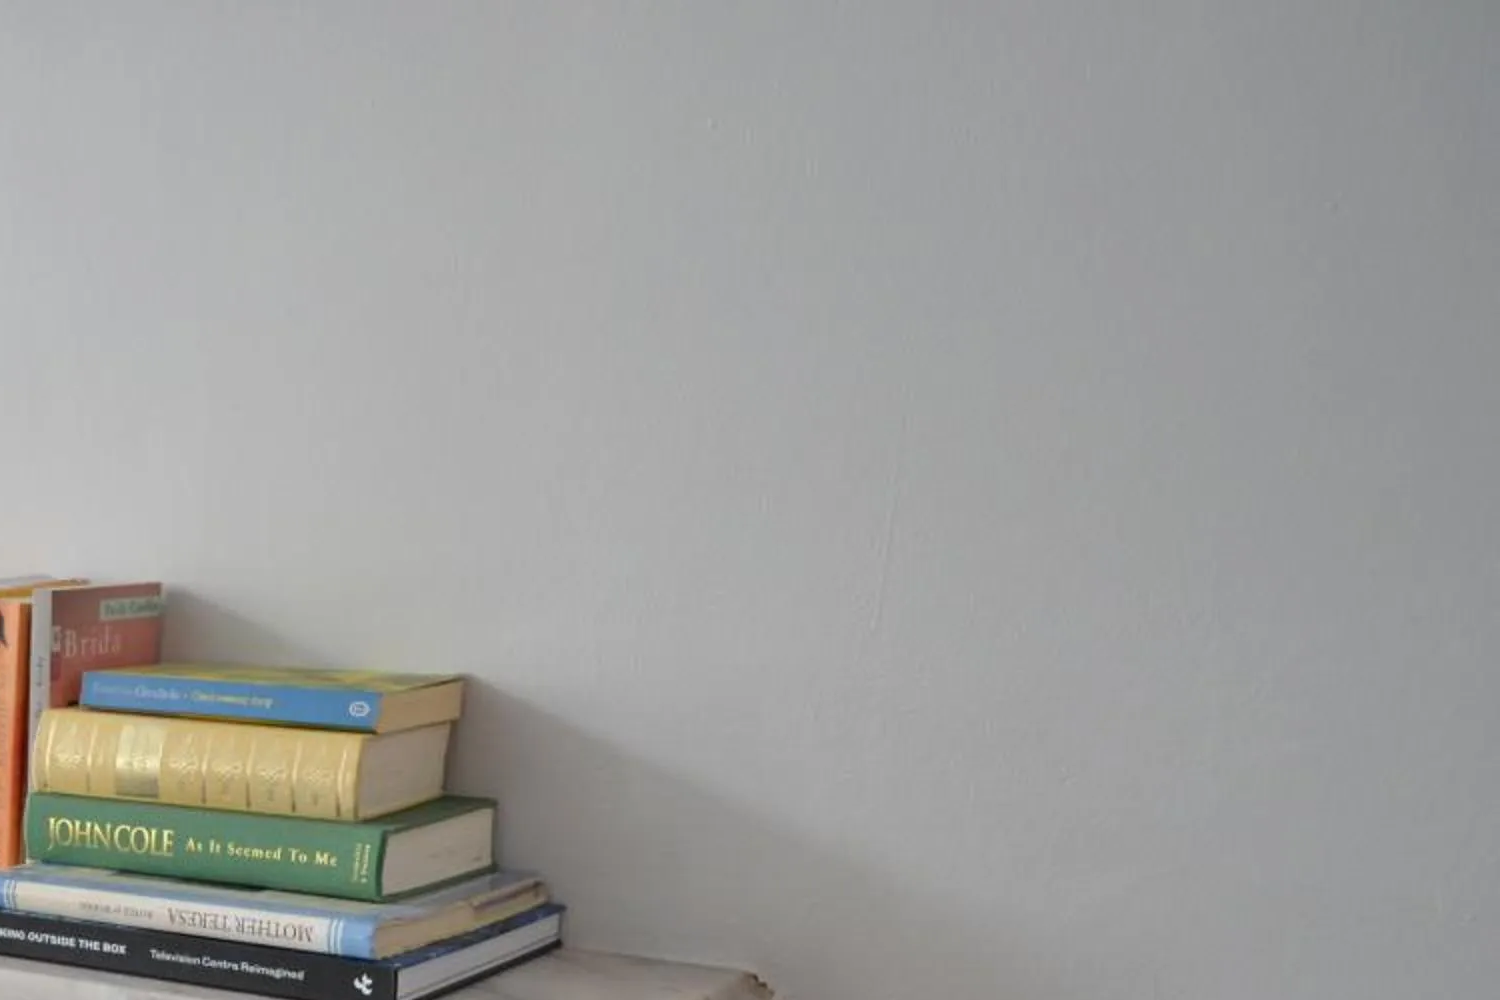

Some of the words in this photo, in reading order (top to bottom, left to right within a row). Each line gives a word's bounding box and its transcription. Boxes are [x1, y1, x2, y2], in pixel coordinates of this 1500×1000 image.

[63, 624, 121, 658] Brida
[48, 816, 111, 850] JOHN
[114, 825, 174, 857] COLE
[186, 837, 203, 853] As
[209, 839, 221, 853] It
[227, 841, 282, 861] Seemed
[288, 847, 307, 864] To
[314, 850, 337, 867] Me
[167, 907, 229, 932] TERESA
[235, 914, 314, 944] MOTHER
[28, 931, 77, 948] OUTSIDE
[78, 938, 101, 951] THE
[102, 942, 127, 955] BOX
[150, 950, 201, 965] Television
[241, 962, 305, 980] Reimagined
